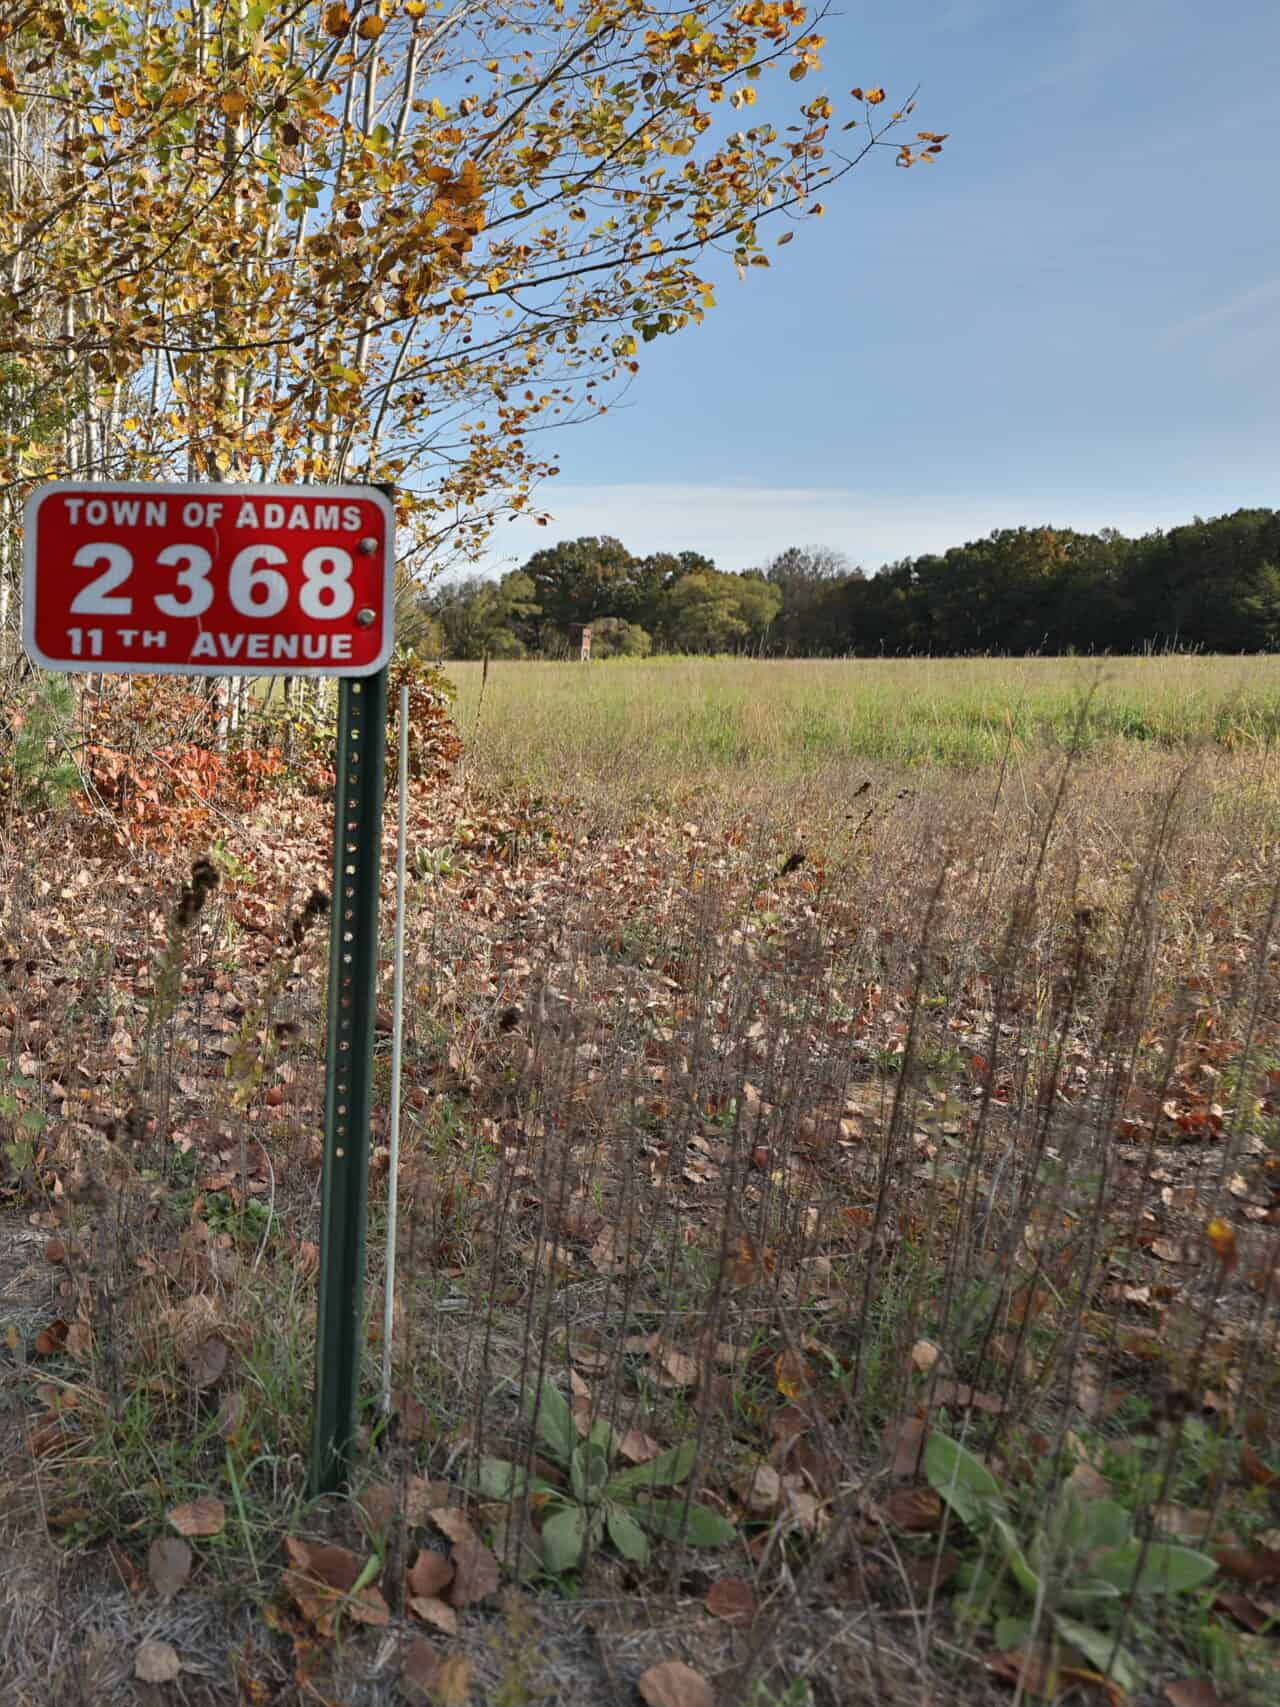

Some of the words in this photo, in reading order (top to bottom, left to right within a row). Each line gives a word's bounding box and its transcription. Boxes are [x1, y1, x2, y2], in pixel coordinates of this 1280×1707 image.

[64, 499, 167, 527] TOWN
[182, 502, 224, 528] OF
[235, 503, 362, 531] ADAMS
[69, 542, 355, 620] 2368
[190, 631, 353, 659] AVENUE
